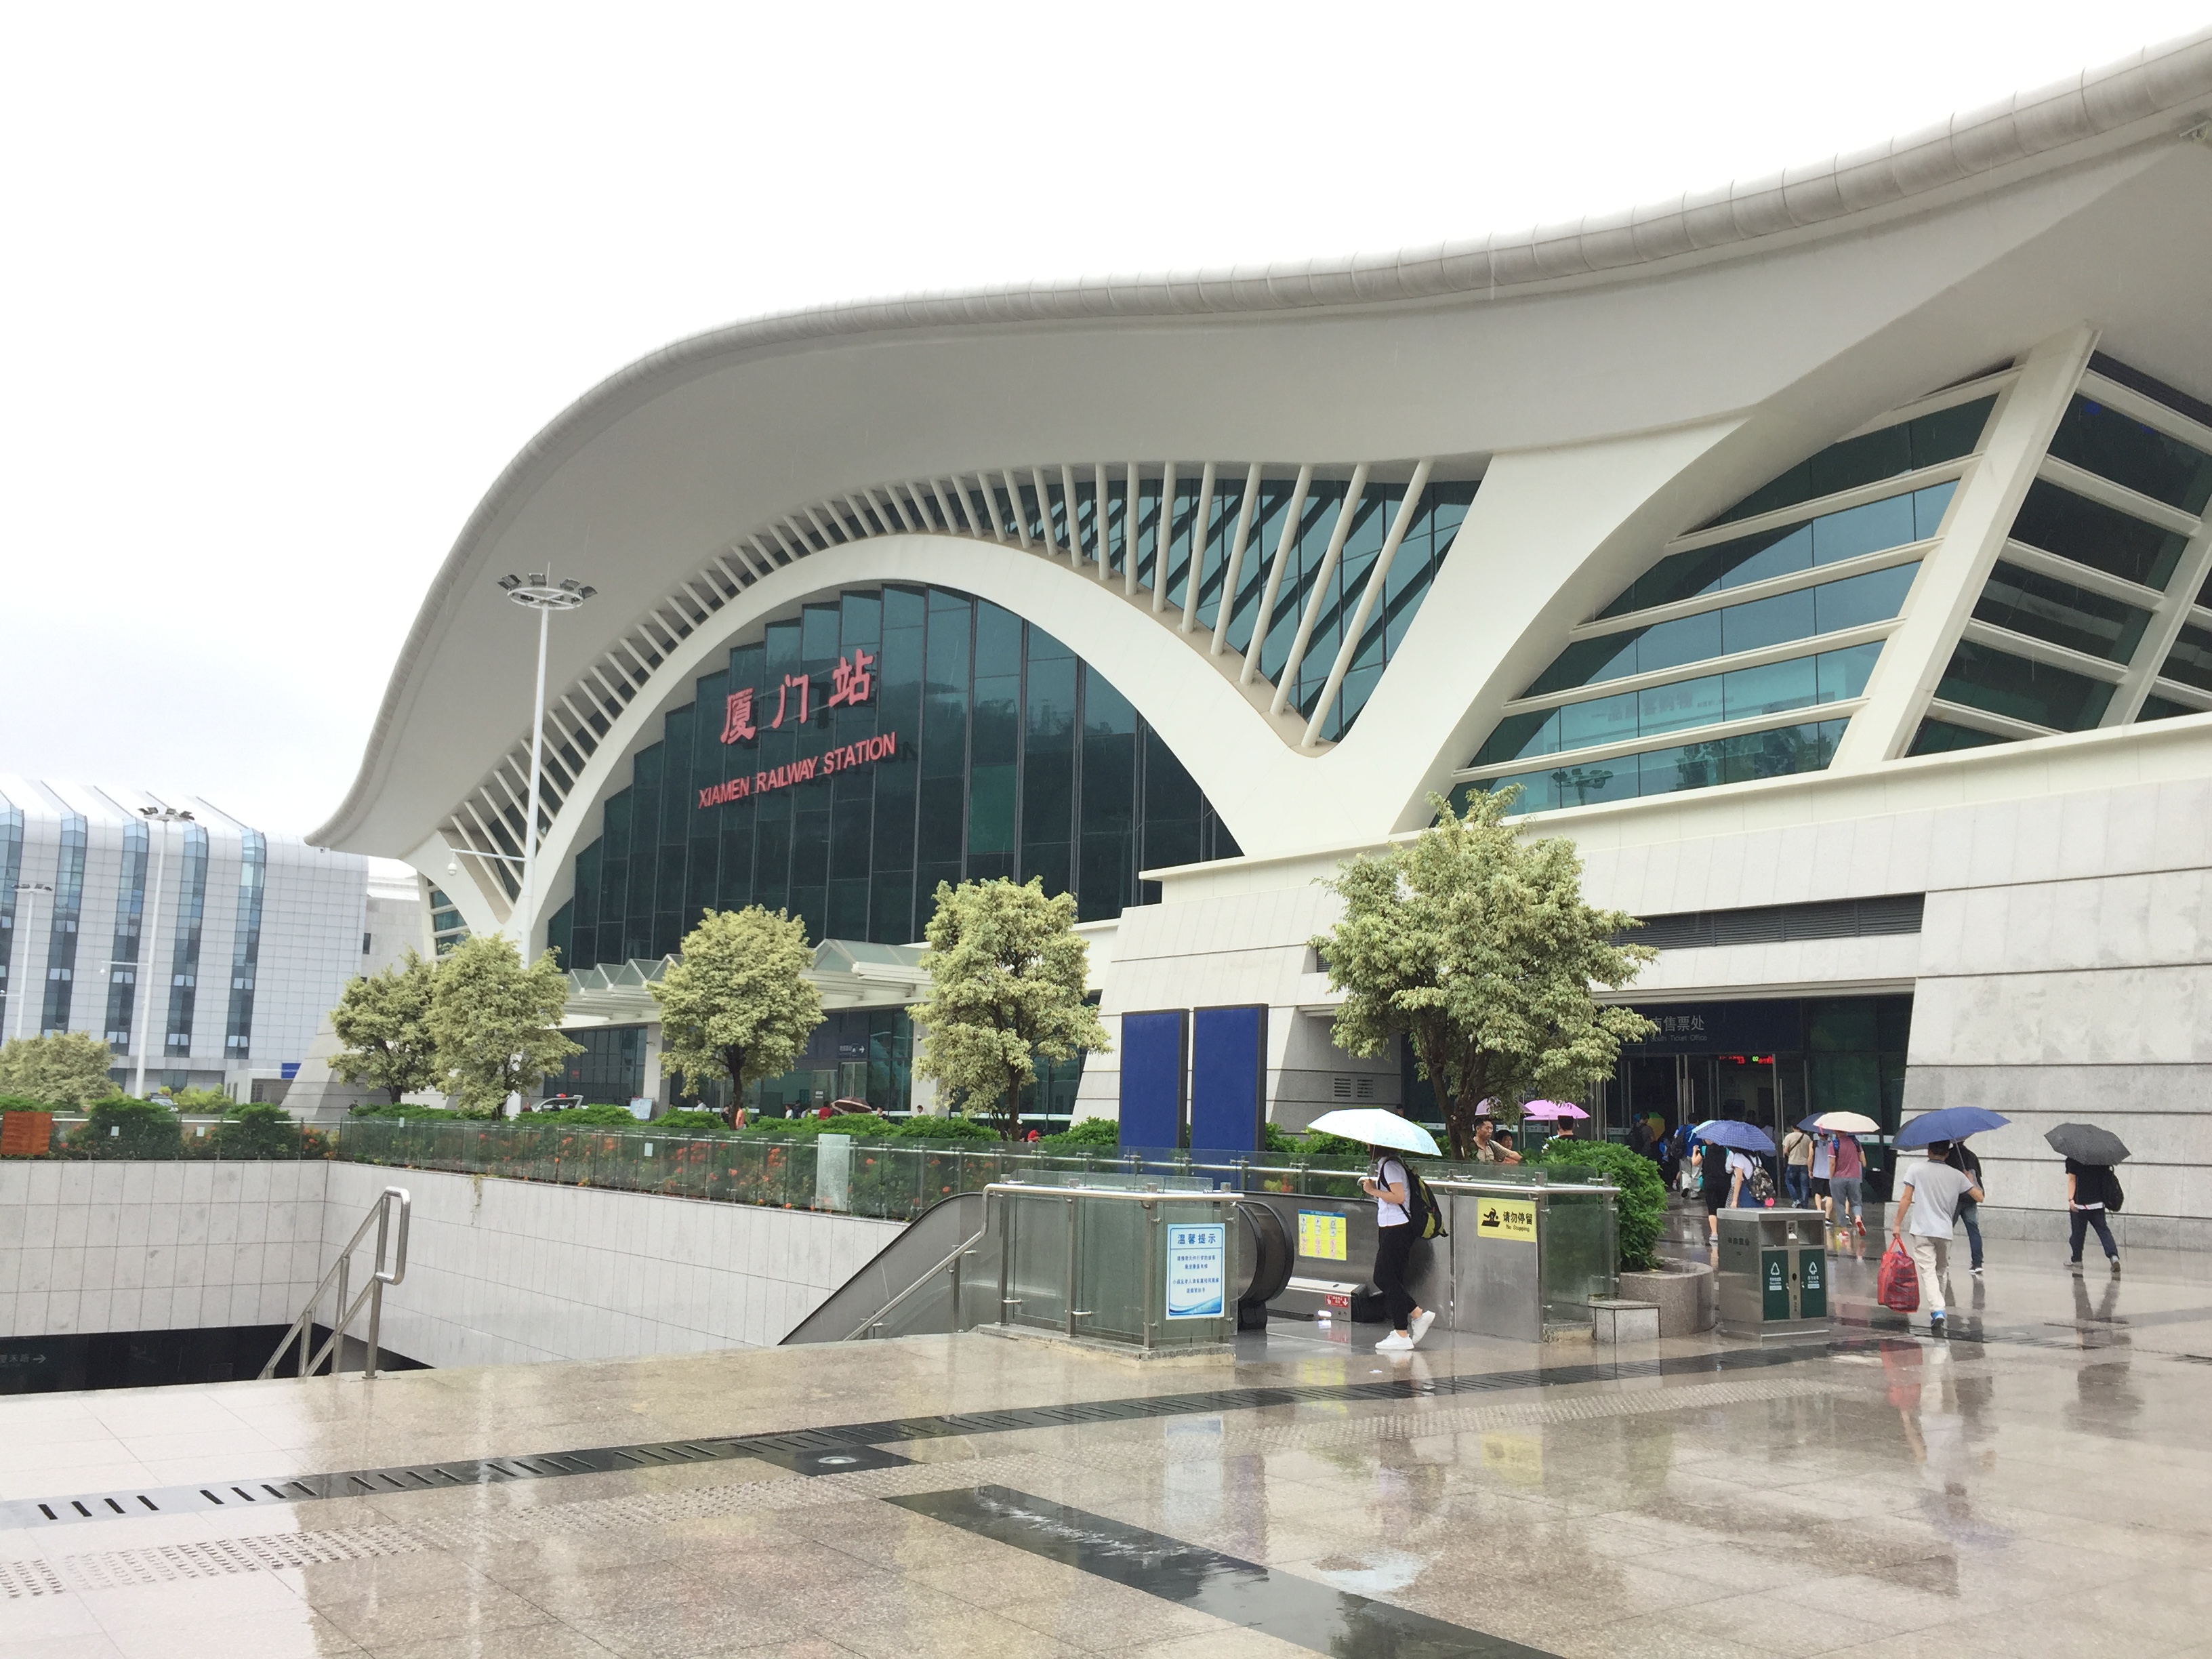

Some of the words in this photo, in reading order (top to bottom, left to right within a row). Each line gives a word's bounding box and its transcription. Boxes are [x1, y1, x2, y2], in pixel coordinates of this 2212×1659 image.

[720, 649, 874, 744] 厦门站
[698, 776, 750, 809] XIAMEN
[756, 756, 819, 794] RAILWAY
[823, 731, 896, 774] STATION
[1690, 1033, 1708, 1042] Office
[1503, 1211, 1533, 1225] 请勿停留
[1177, 1233, 1216, 1244] 温馨提示
